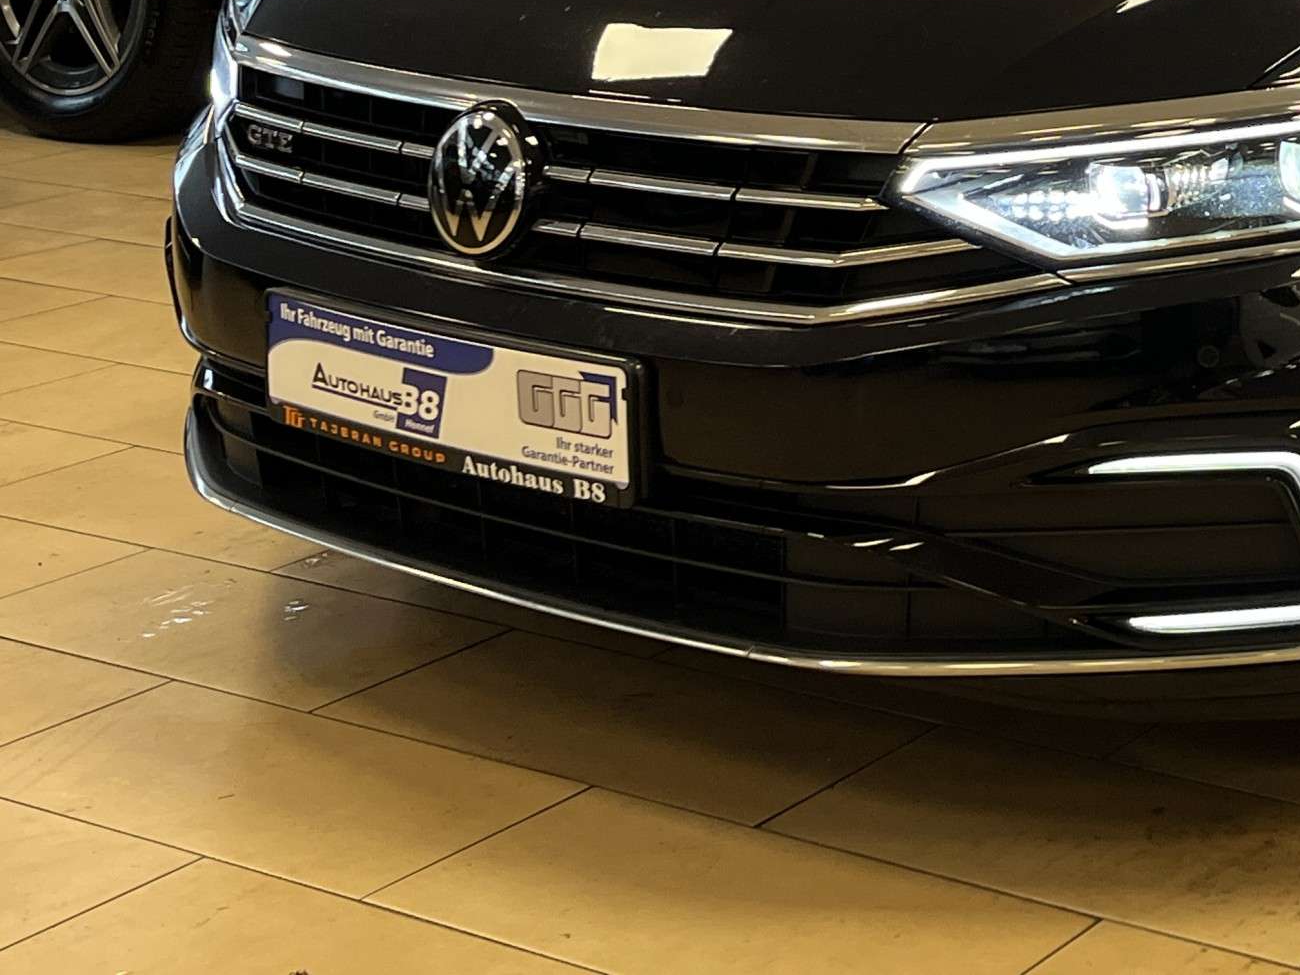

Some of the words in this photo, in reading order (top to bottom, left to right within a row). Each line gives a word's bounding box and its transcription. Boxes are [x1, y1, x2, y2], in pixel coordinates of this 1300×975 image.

[247, 124, 294, 153] GTE
[279, 302, 295, 323] Ihr
[297, 308, 351, 342] Fahrzeug
[353, 326, 375, 345] mit
[376, 329, 436, 358] Garantie
[388, 440, 446, 464] GROUP
[521, 445, 615, 475] Garantie-Partner
[556, 437, 571, 451] Ihr
[574, 442, 614, 459] starker
[462, 455, 564, 494] Autohaus
[573, 478, 606, 503] B8
